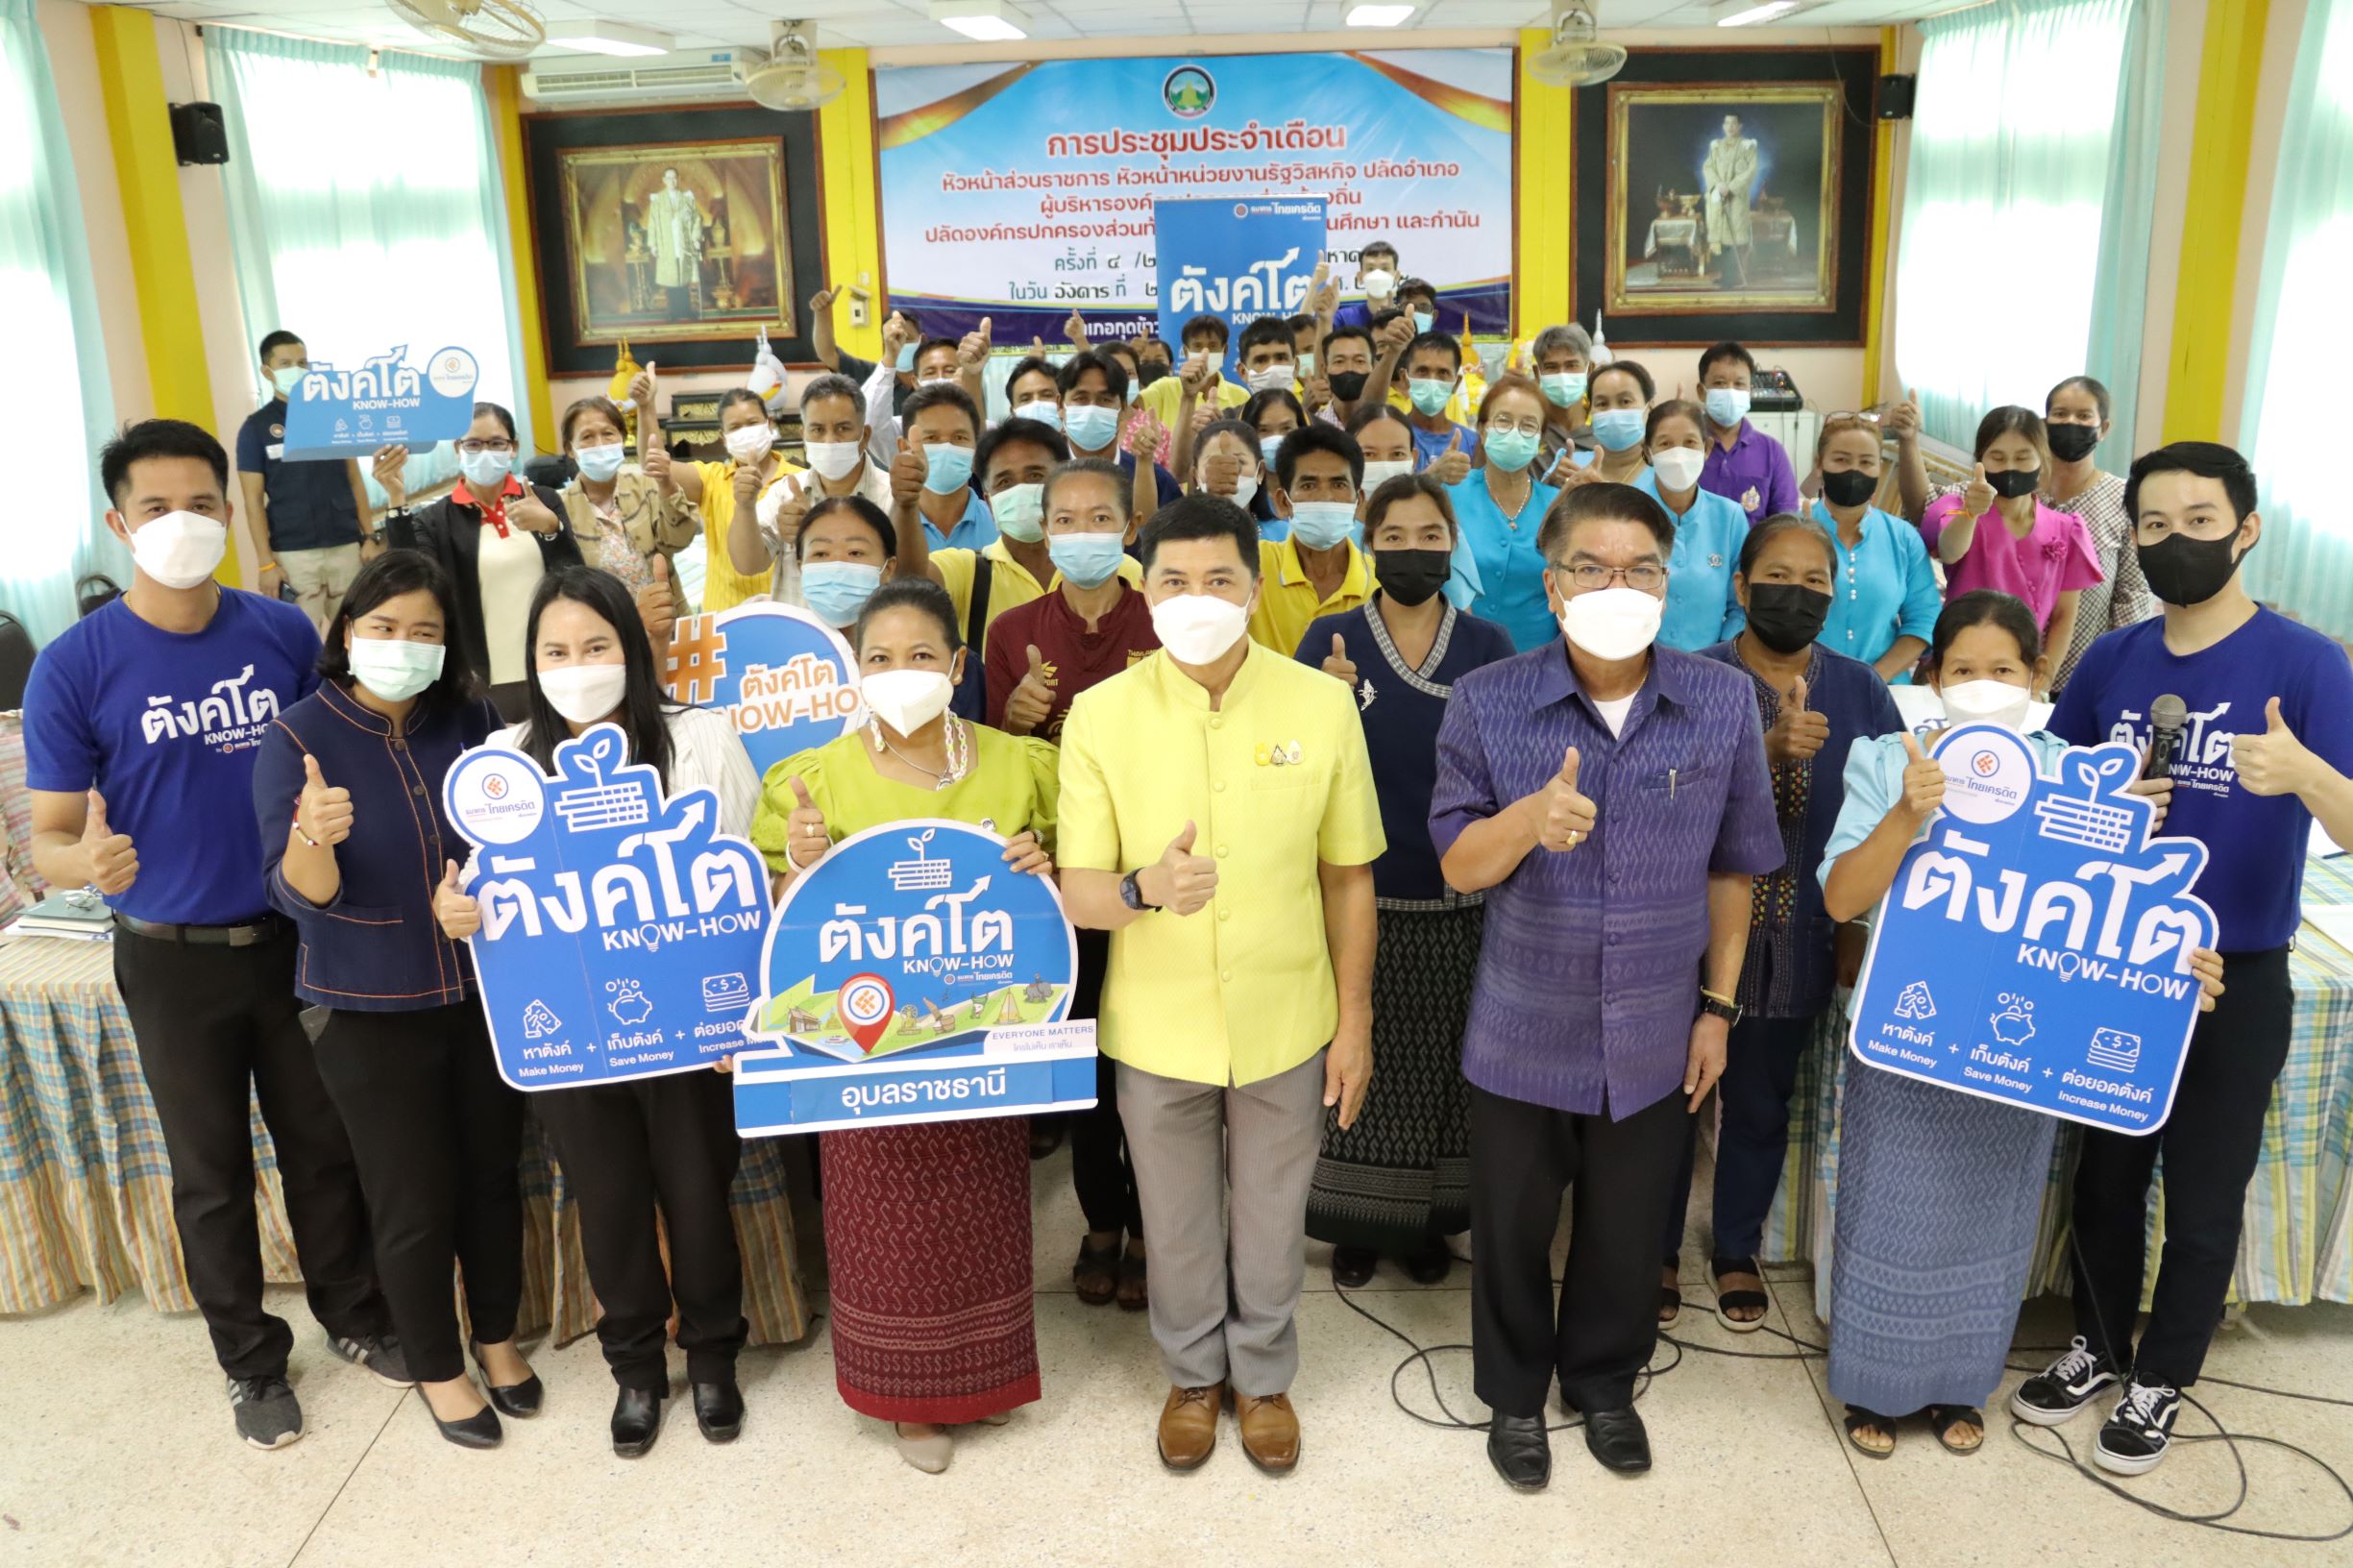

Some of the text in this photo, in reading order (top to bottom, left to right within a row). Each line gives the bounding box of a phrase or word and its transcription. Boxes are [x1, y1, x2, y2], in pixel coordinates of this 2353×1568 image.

[1048, 121, 1344, 160] การประชุมประจำเดือน
[943, 159, 1459, 191] หัวหน้าส่วนราชการ หัวหน้าหน่วยงานรัฐวิสหกิจ ปลัดอำเภอ
[1041, 193, 1152, 218] ผู้บริหารองค์
[1397, 210, 1480, 229] และกำนัน
[1055, 247, 1097, 271] ครั้งที่
[1009, 282, 1047, 300] ในวัน
[1115, 274, 1126, 297] ที่
[303, 344, 421, 402] ตังค์โต
[353, 398, 420, 410] KNOW-HOW
[744, 656, 834, 699] ตังค์โต
[204, 723, 268, 745] KNOW-H
[478, 800, 757, 942] ตังค์โต
[1902, 829, 2203, 975] ตังค์โต
[602, 910, 761, 952] KNOW-HOW
[820, 875, 1013, 963] ตังค์โต
[903, 953, 1015, 977] KNOW-HOW
[2018, 943, 2191, 1000] KNOW-HOW
[523, 1040, 572, 1060] หาตังค์
[607, 1028, 663, 1051] เก็บตังค์
[699, 1040, 745, 1053] Increase
[993, 1025, 1093, 1040] EVERYONE MATTERS
[609, 1050, 674, 1067] Save Money
[1868, 1040, 1937, 1068] Make Money
[1881, 1022, 1935, 1047] หาตังค์
[1971, 1044, 2032, 1073] เก็บตังค์
[2061, 1069, 2154, 1104] ต่อยอดตังค์
[518, 1063, 584, 1077] Make Money
[1964, 1066, 2032, 1093] Save Money
[842, 1066, 1006, 1115] อุบลราชธานี
[2058, 1090, 2148, 1122] Increase Money
